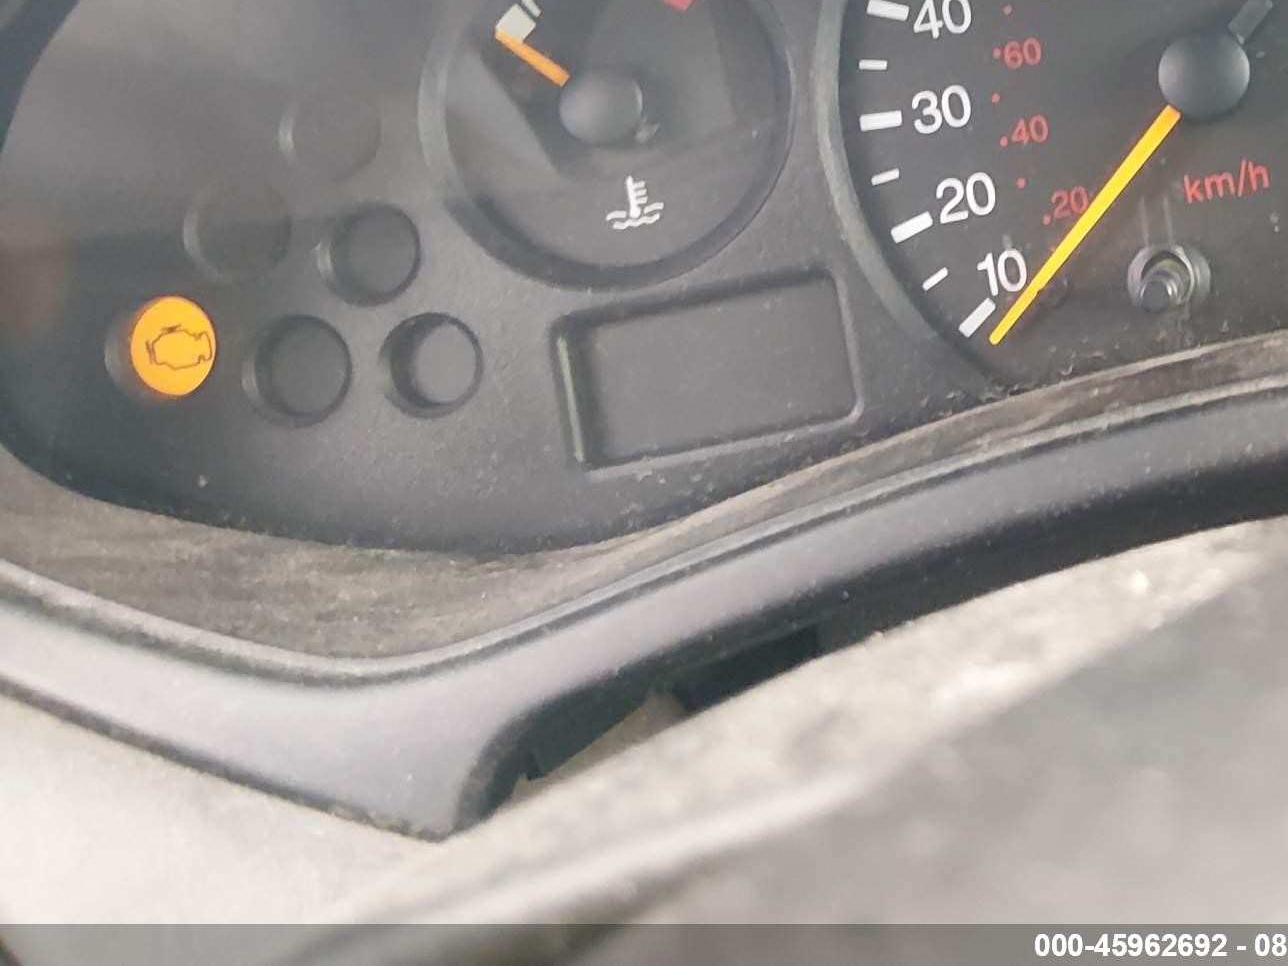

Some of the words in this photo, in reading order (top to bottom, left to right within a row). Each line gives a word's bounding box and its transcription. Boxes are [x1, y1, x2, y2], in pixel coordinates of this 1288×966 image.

[1003, 37, 1042, 69] 60
[911, 84, 972, 134] 30
[1010, 115, 1049, 145] 40
[936, 172, 996, 224] 20
[1051, 186, 1089, 219] 20
[1183, 159, 1270, 204] km/h
[976, 248, 1028, 296] 10
